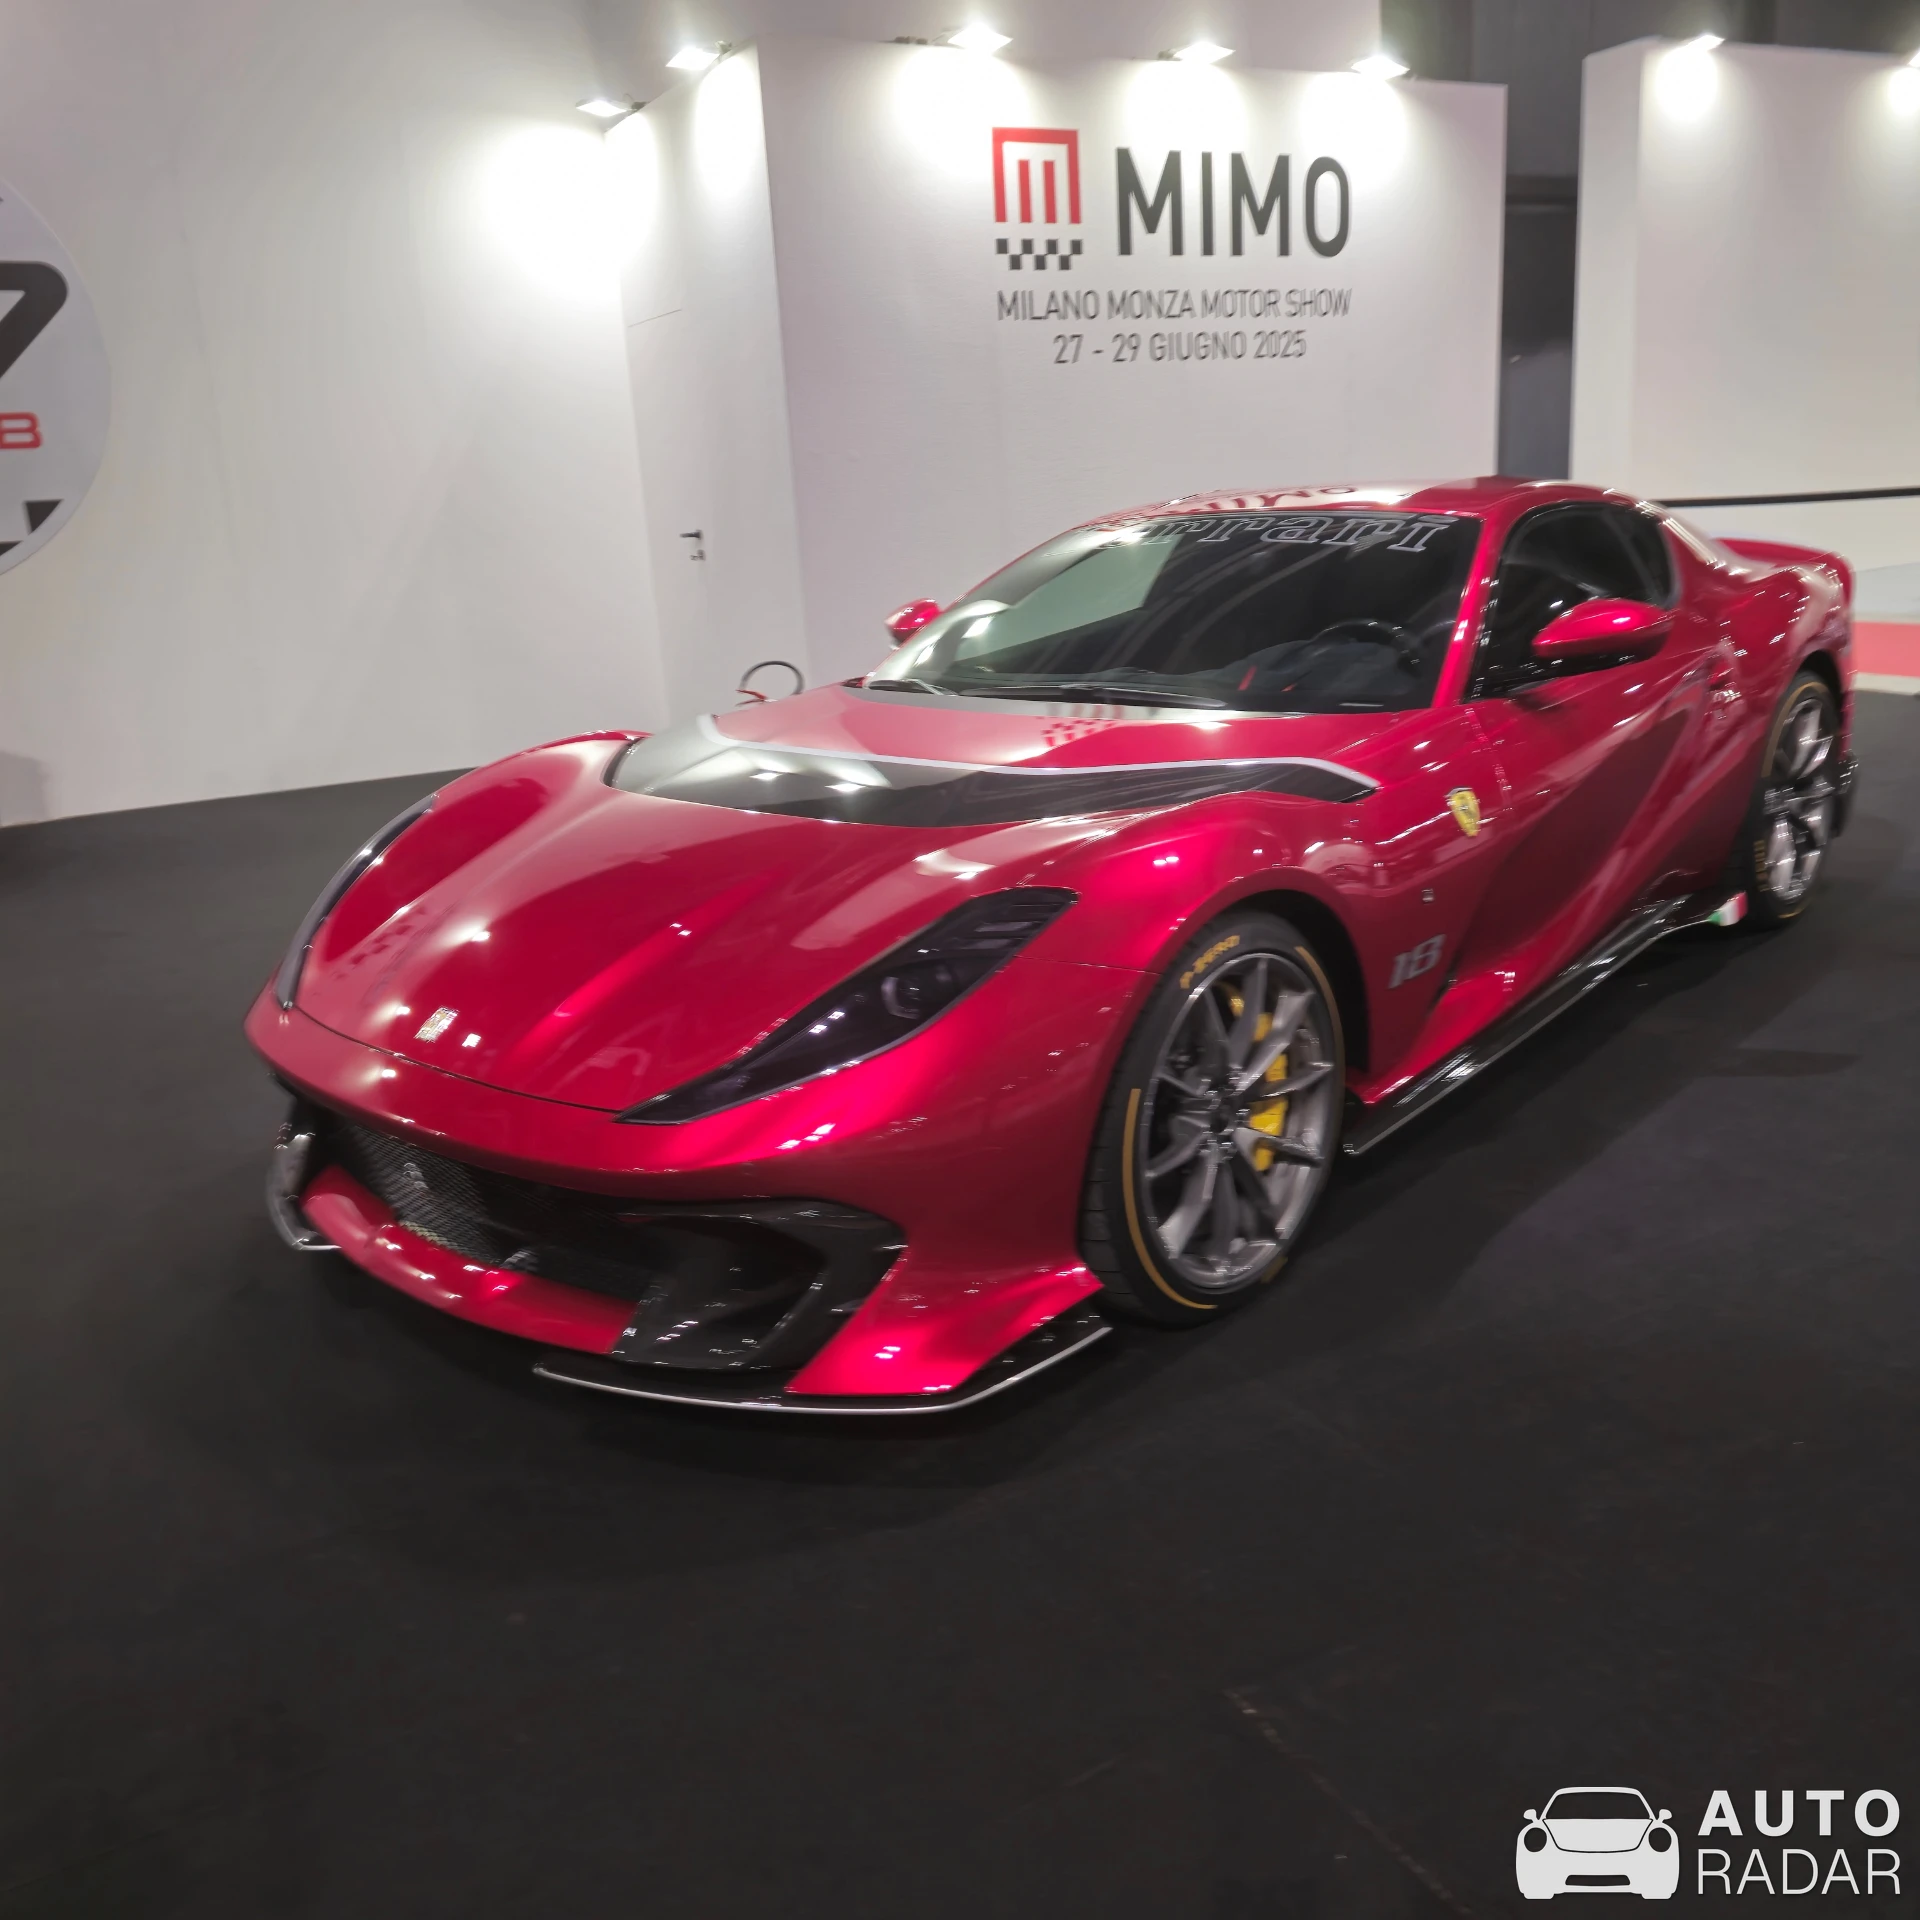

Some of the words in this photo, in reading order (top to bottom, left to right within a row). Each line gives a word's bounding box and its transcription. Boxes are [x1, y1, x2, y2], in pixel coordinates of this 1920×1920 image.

[1115, 146, 1351, 258] MIMO
[996, 289, 1100, 321] MILANO
[1107, 288, 1197, 320] MONZA
[1200, 288, 1281, 319] MOTOR
[1284, 287, 1353, 318] SHOW
[1053, 333, 1084, 364] 27
[1111, 332, 1142, 363] 29
[1149, 330, 1248, 361] GIUGNO
[1253, 329, 1308, 359] 2025
